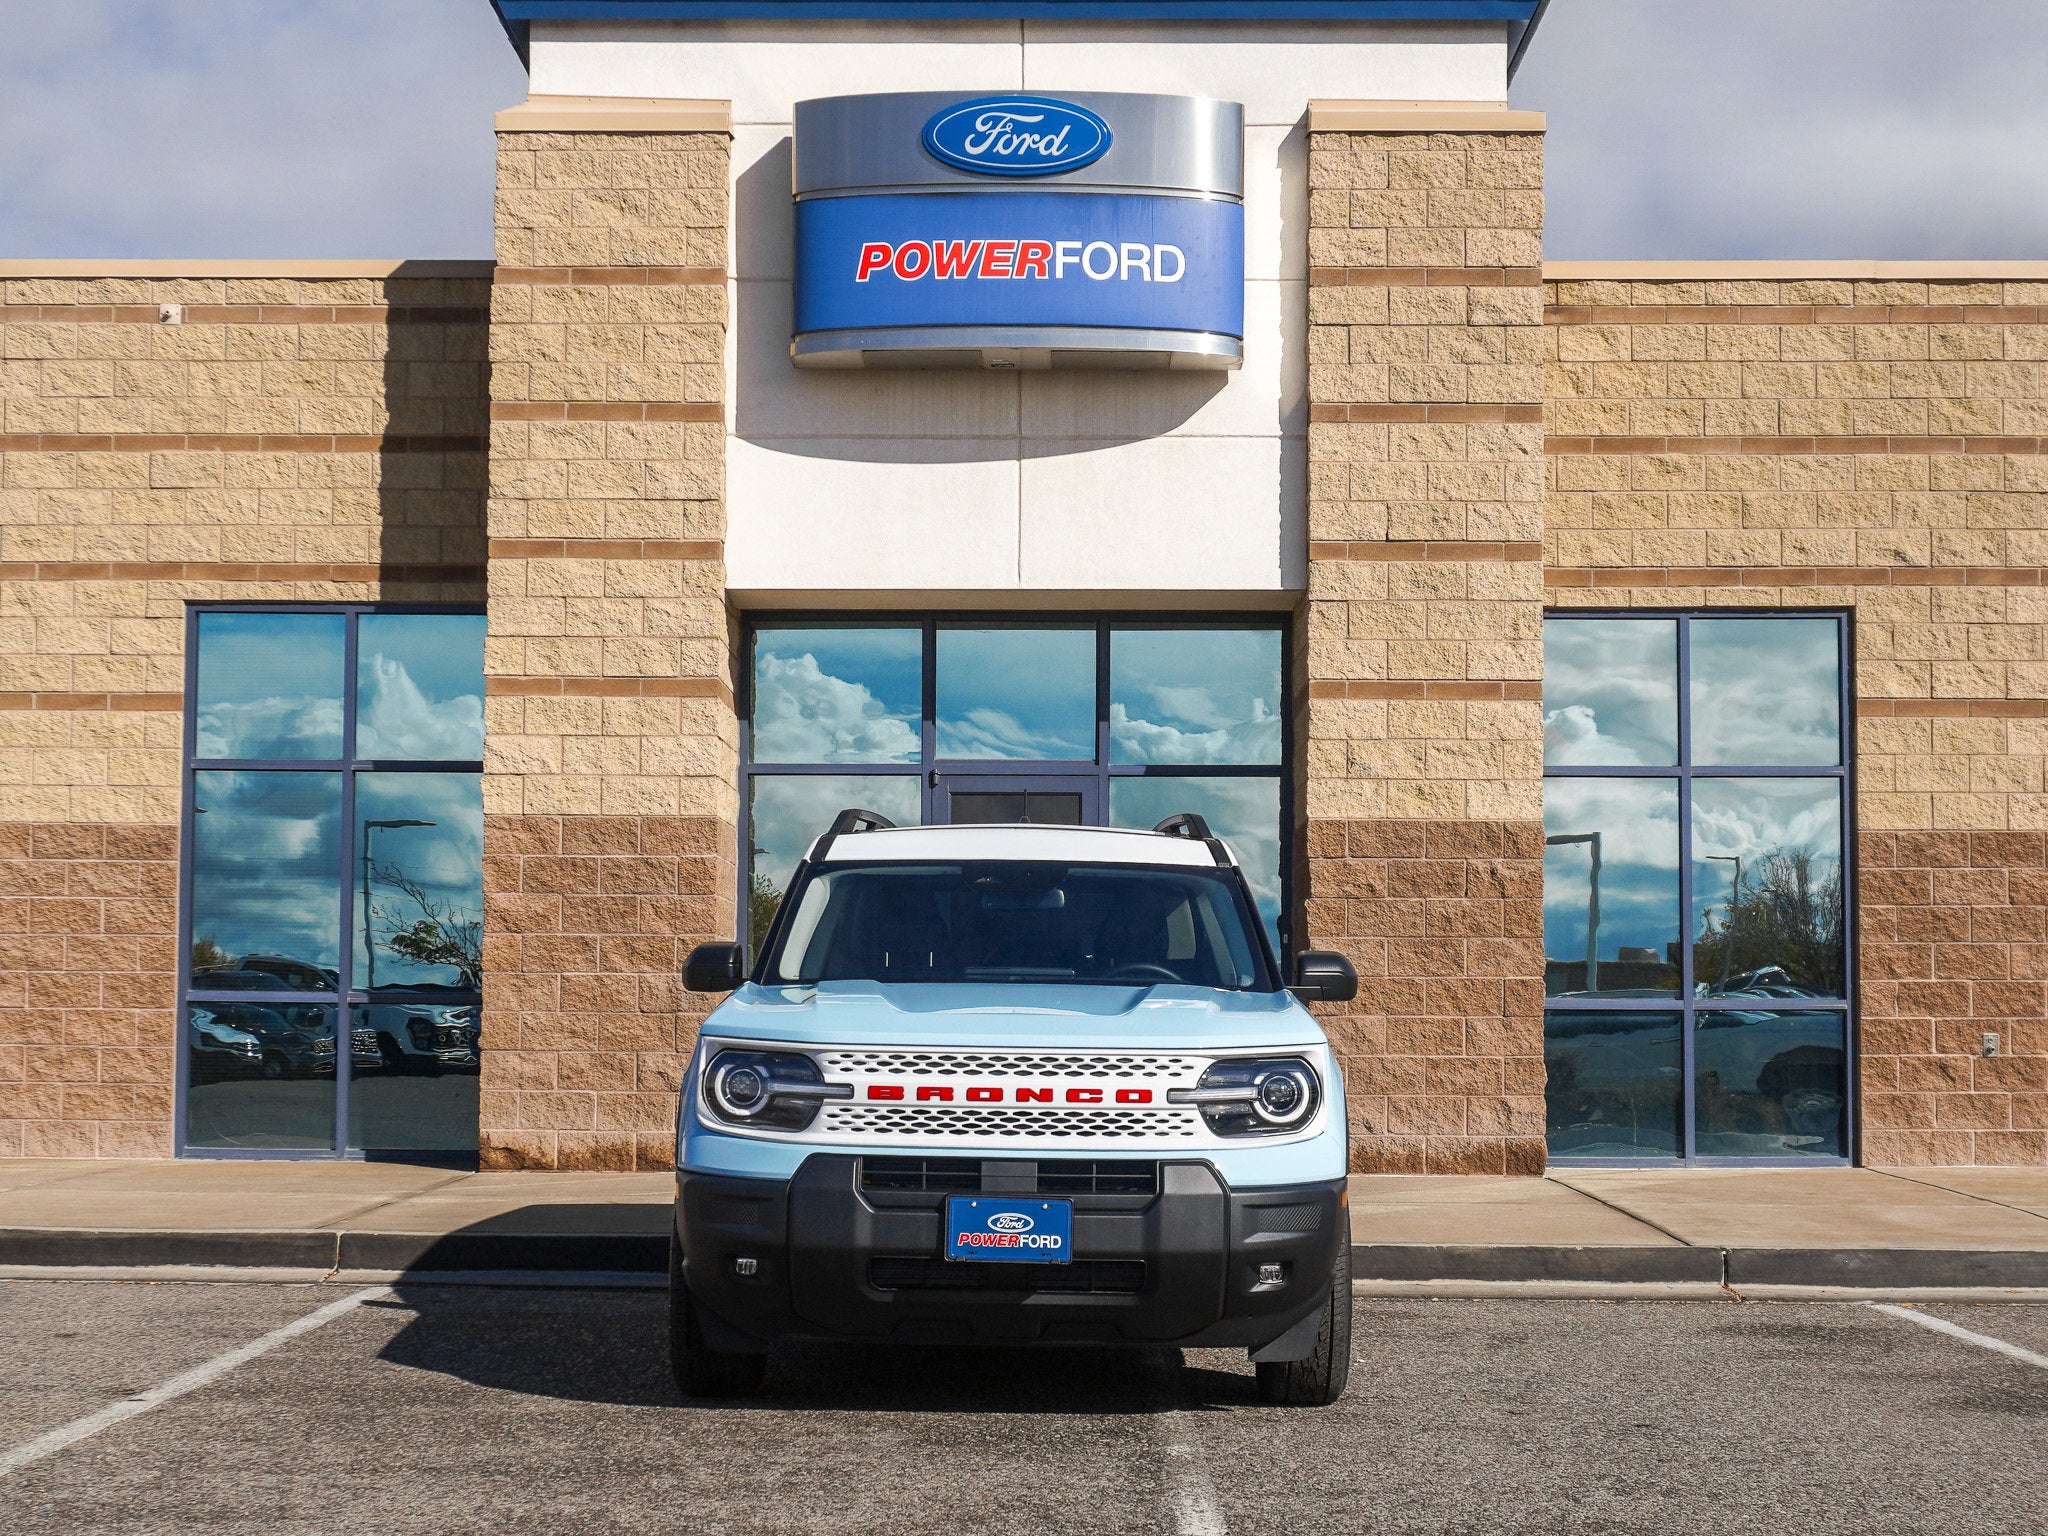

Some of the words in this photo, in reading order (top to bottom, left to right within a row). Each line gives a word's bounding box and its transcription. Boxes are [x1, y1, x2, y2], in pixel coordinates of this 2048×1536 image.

[964, 111, 1071, 157] Ford
[867, 1084, 1153, 1104] BRONCO
[996, 1215, 1024, 1229] Ford
